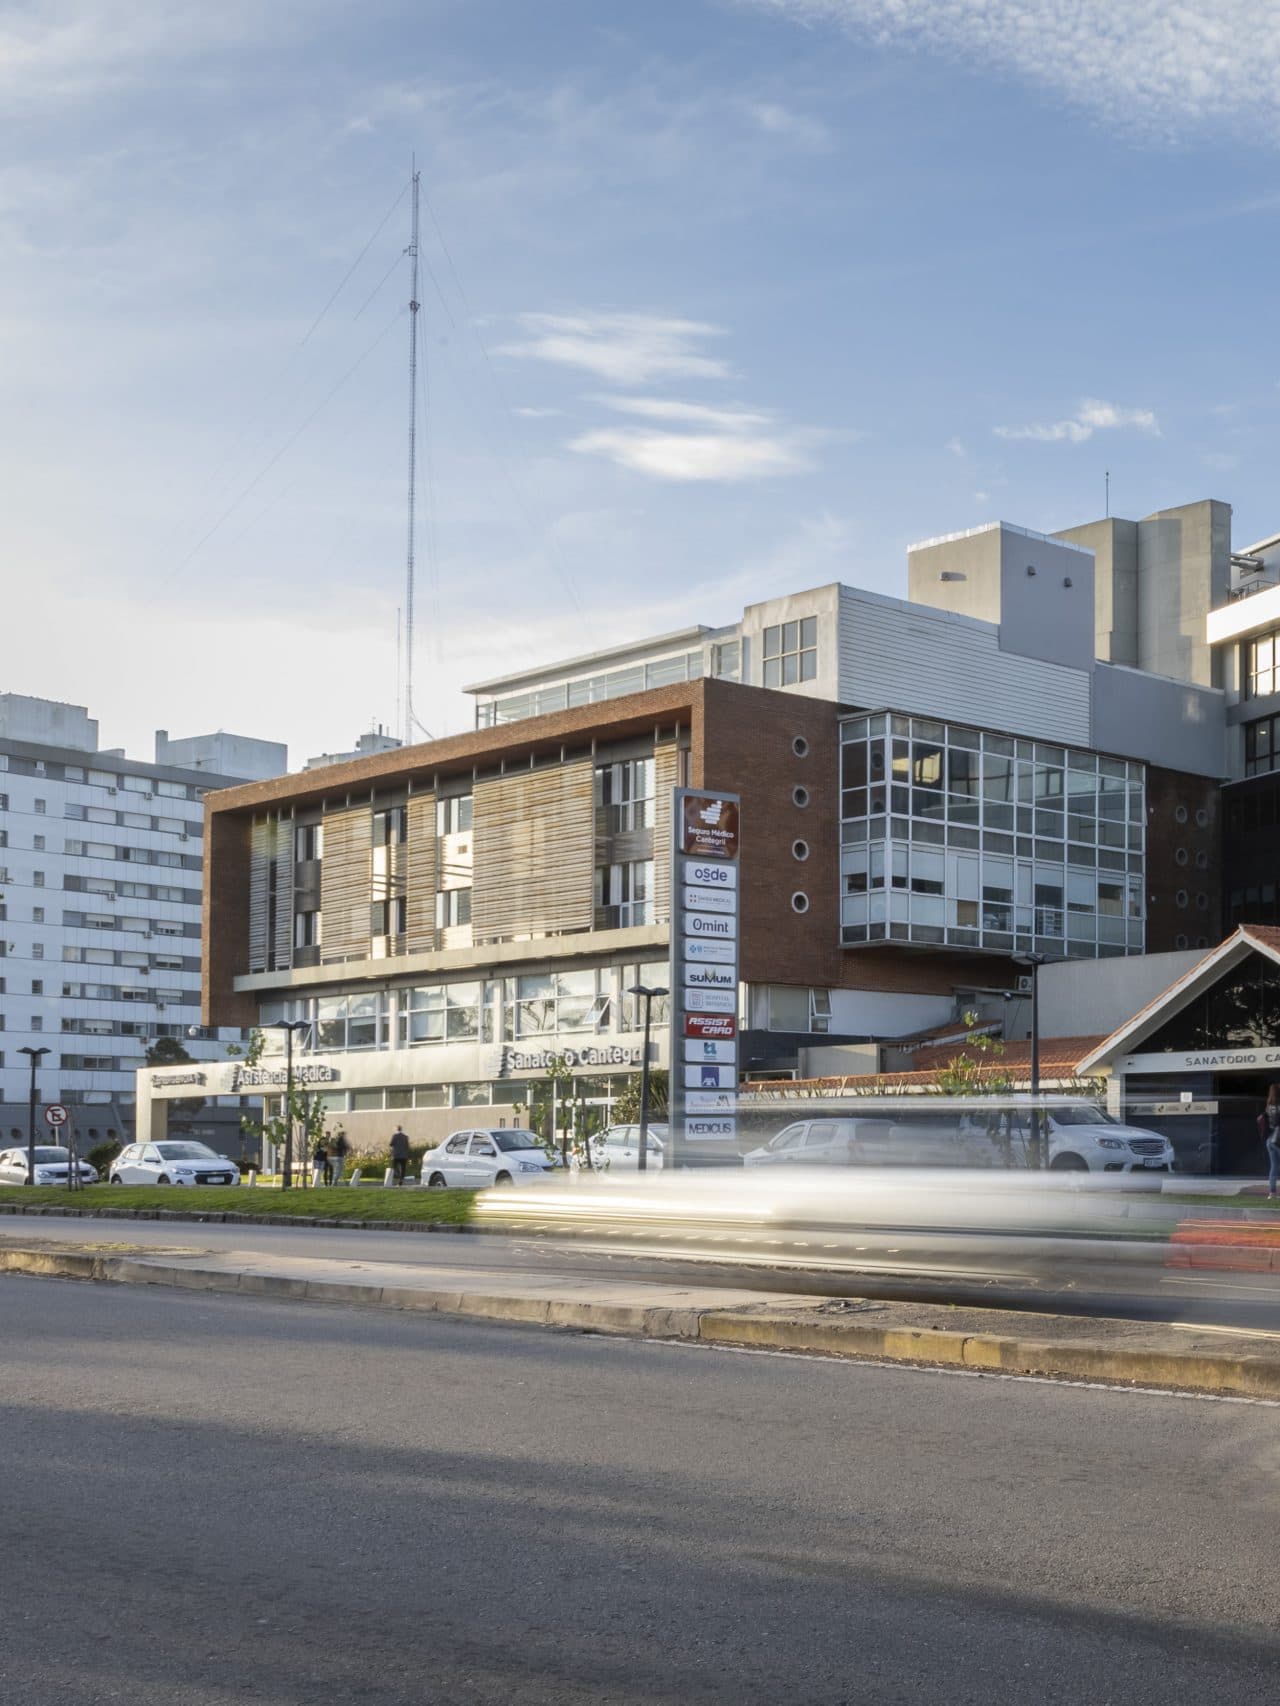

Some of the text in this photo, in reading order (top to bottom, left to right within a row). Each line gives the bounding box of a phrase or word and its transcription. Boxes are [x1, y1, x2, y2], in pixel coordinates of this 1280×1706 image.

[696, 835, 726, 845] Cantegril
[695, 868, 728, 882] osde
[692, 918, 729, 933] Omint
[689, 1017, 731, 1026] ASSIST
[702, 1026, 732, 1035] CARD
[506, 1046, 648, 1069] Sanatoo Cantegri
[1185, 1055, 1256, 1067] SANATORIO
[688, 1123, 732, 1135] MEDICUS
